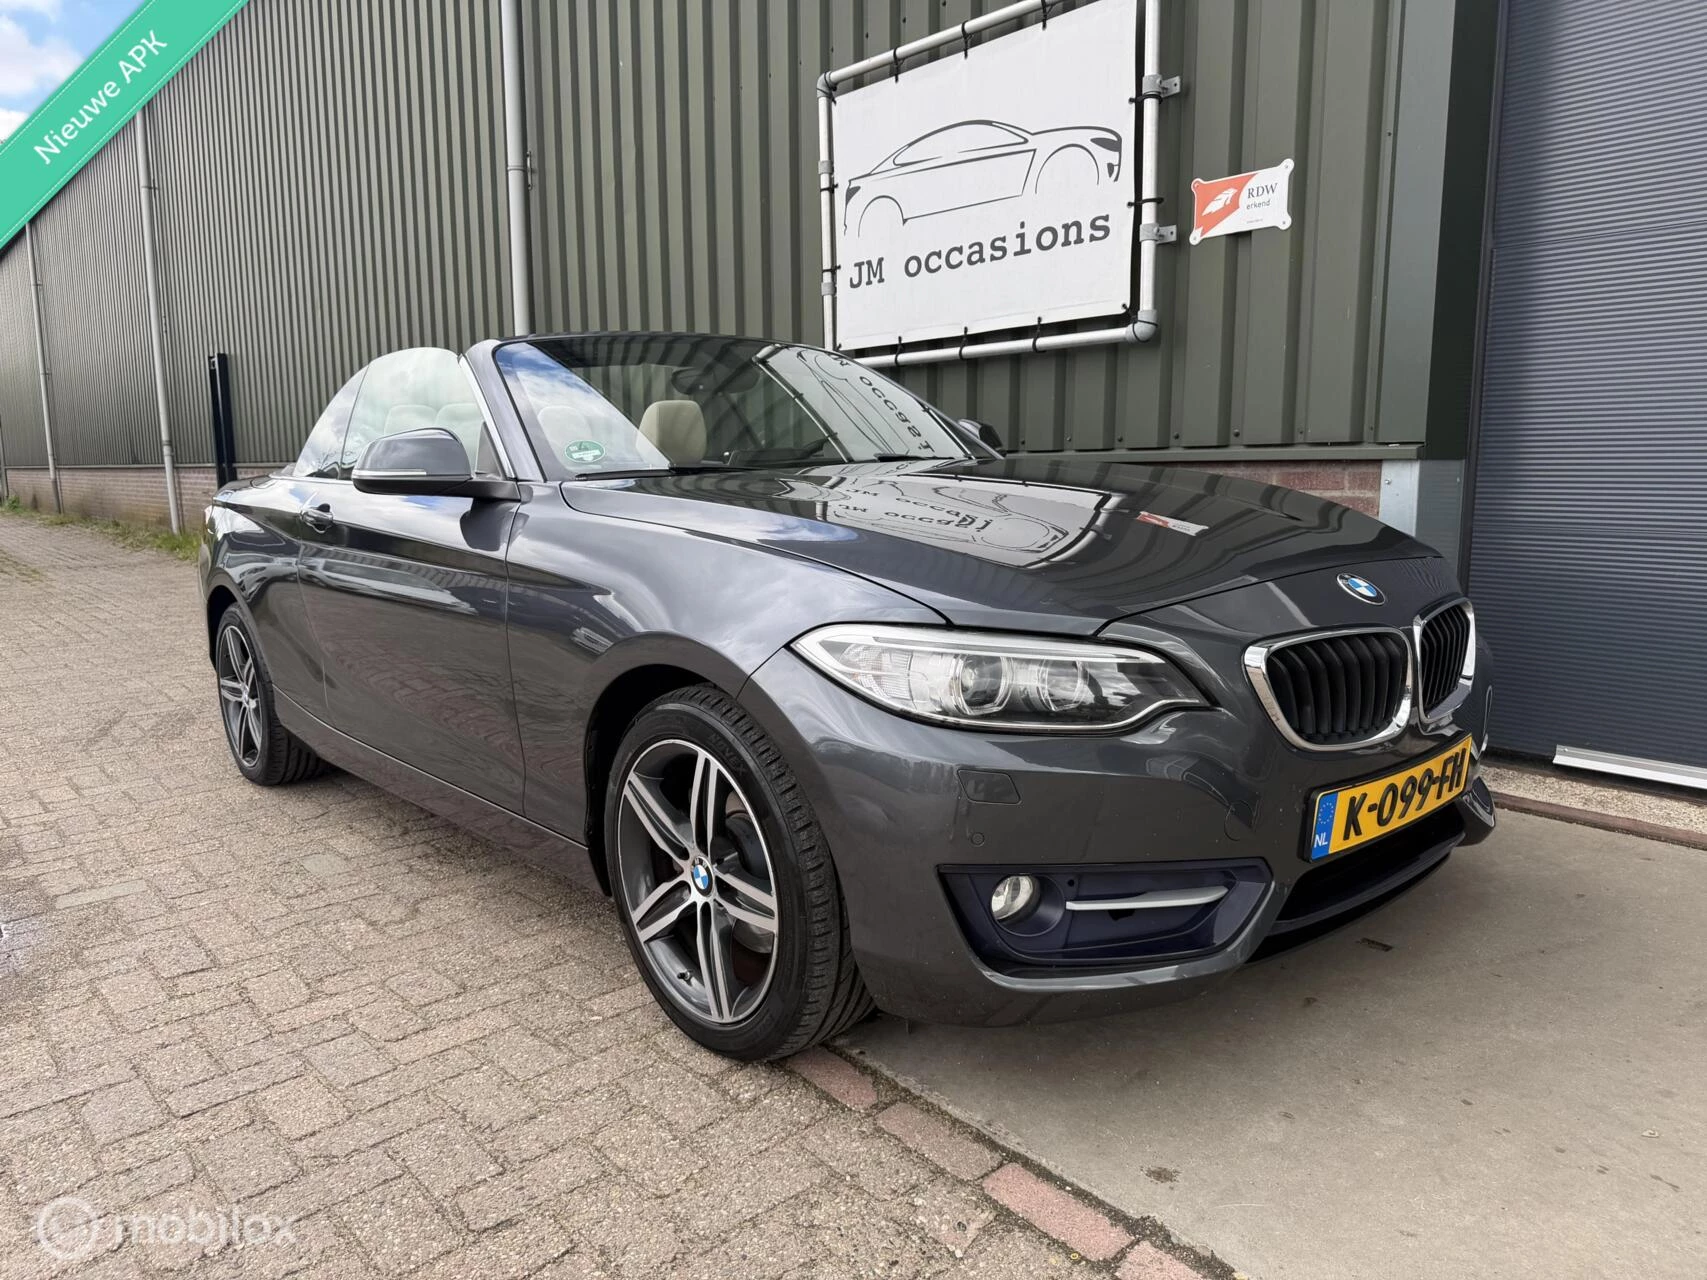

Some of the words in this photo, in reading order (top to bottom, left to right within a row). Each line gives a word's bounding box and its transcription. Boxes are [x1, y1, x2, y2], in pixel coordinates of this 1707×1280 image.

[1247, 183, 1278, 199] RDW
[1246, 199, 1271, 210] erkend
[850, 257, 885, 289] JM
[903, 213, 1111, 278] occasions
[1342, 747, 1467, 841] K-099-FH
[1314, 832, 1329, 848] NL
